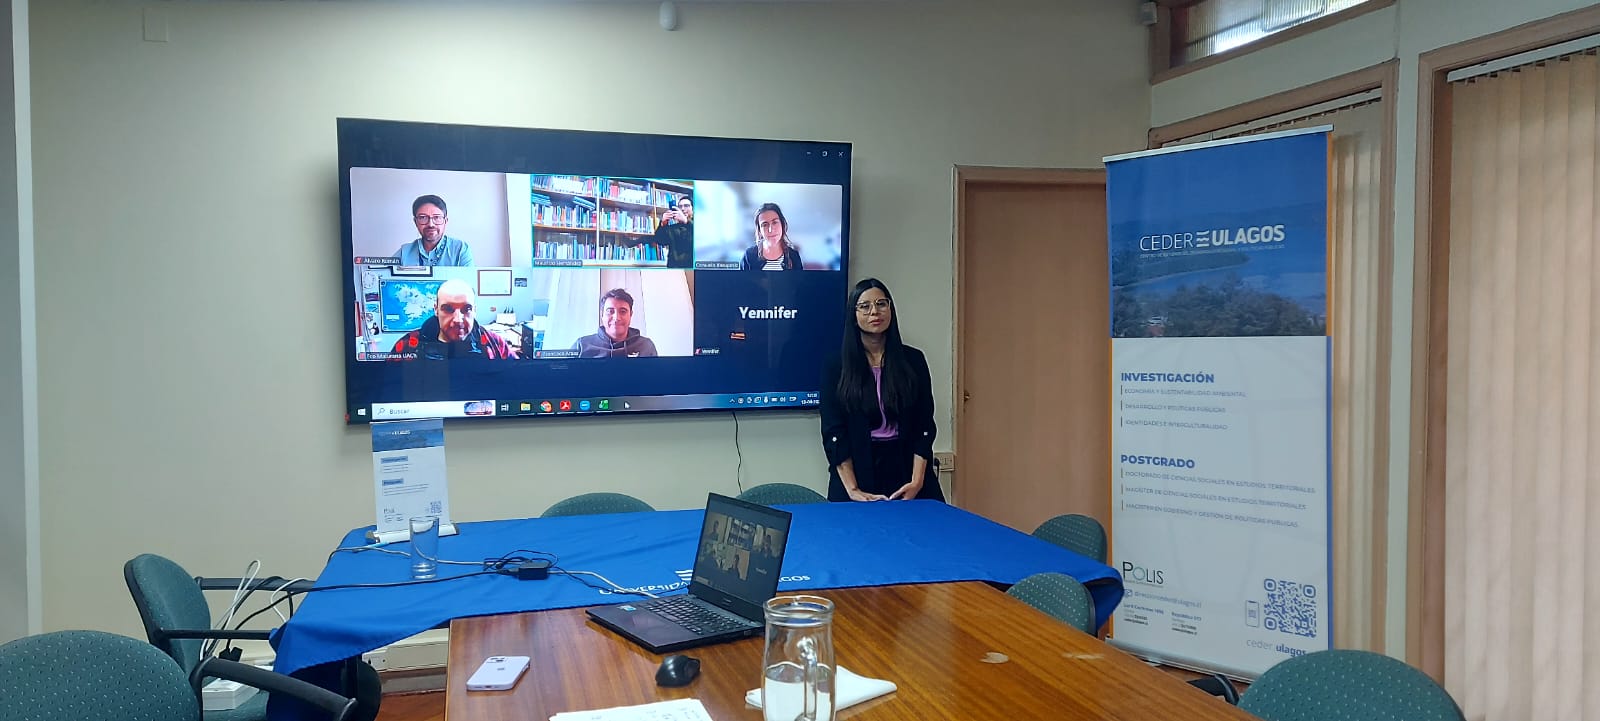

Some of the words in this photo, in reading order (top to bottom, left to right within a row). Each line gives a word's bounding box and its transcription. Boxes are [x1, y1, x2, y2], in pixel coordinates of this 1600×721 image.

[1140, 232, 1194, 251] CEDER
[1212, 224, 1286, 246] ULAGOS
[739, 306, 798, 319] Yennifer
[1121, 371, 1215, 383] INVESTIGACIÓN
[1126, 419, 1163, 427] IDENTIDADES
[1168, 421, 1228, 430] INTERCULTURALIDAD
[1121, 454, 1195, 469] POSTGRADO
[1125, 471, 1161, 479] DOCTORADO
